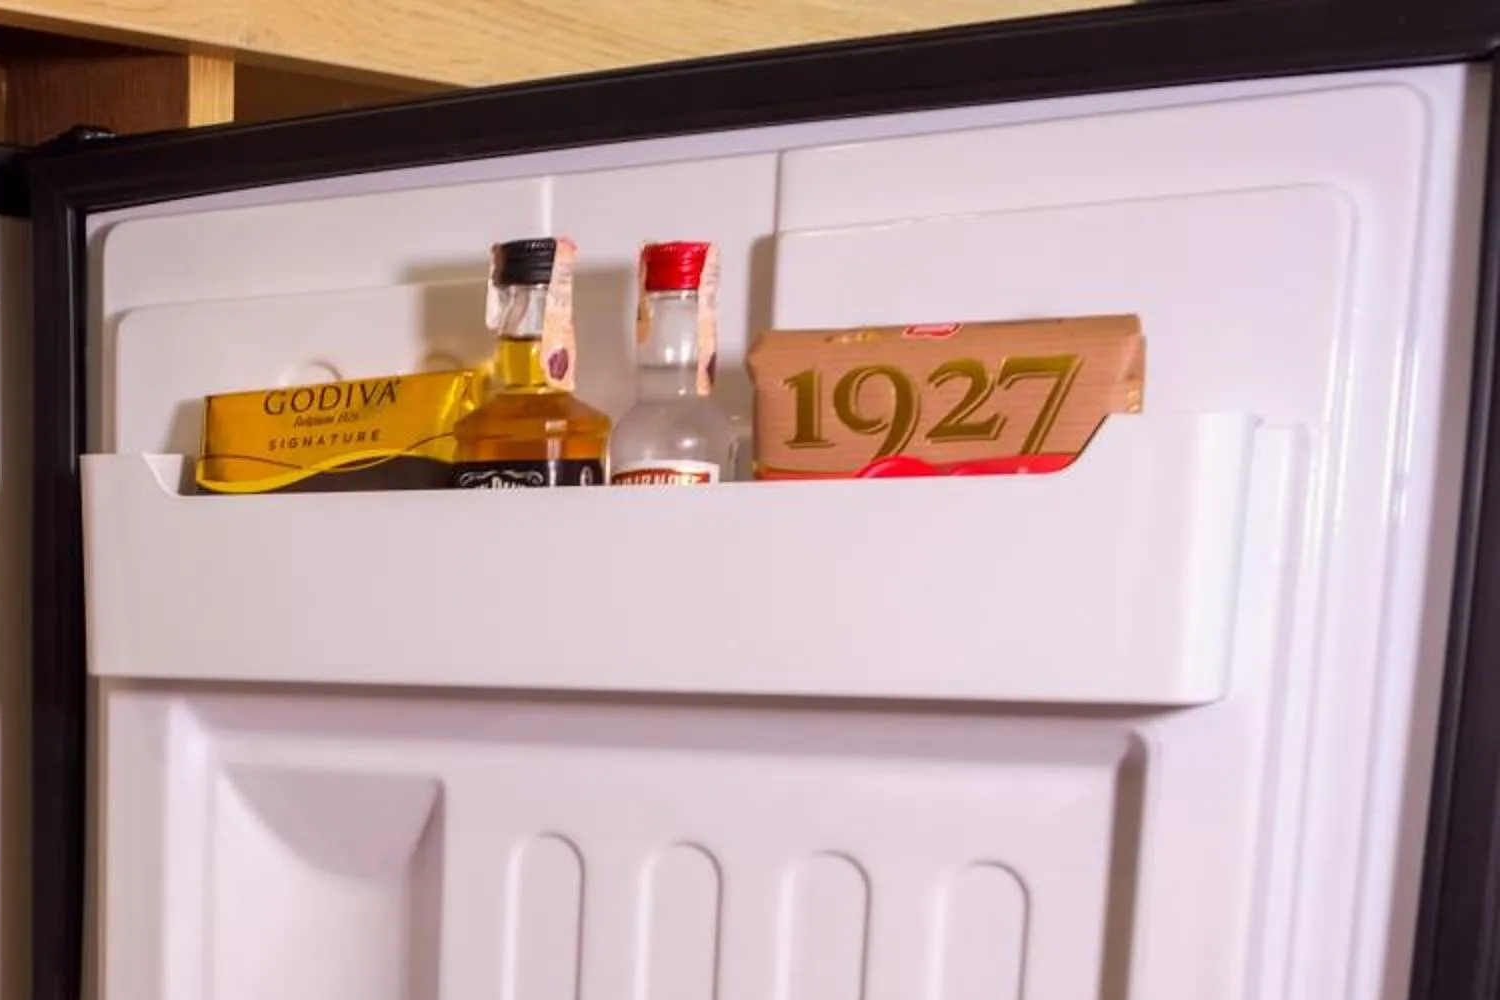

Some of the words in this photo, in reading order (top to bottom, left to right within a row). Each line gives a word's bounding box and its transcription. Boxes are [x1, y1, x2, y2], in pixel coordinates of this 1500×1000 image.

[263, 379, 398, 416] GODIVA
[783, 354, 1083, 462] 1927
[268, 428, 381, 453] SIGNATURE
